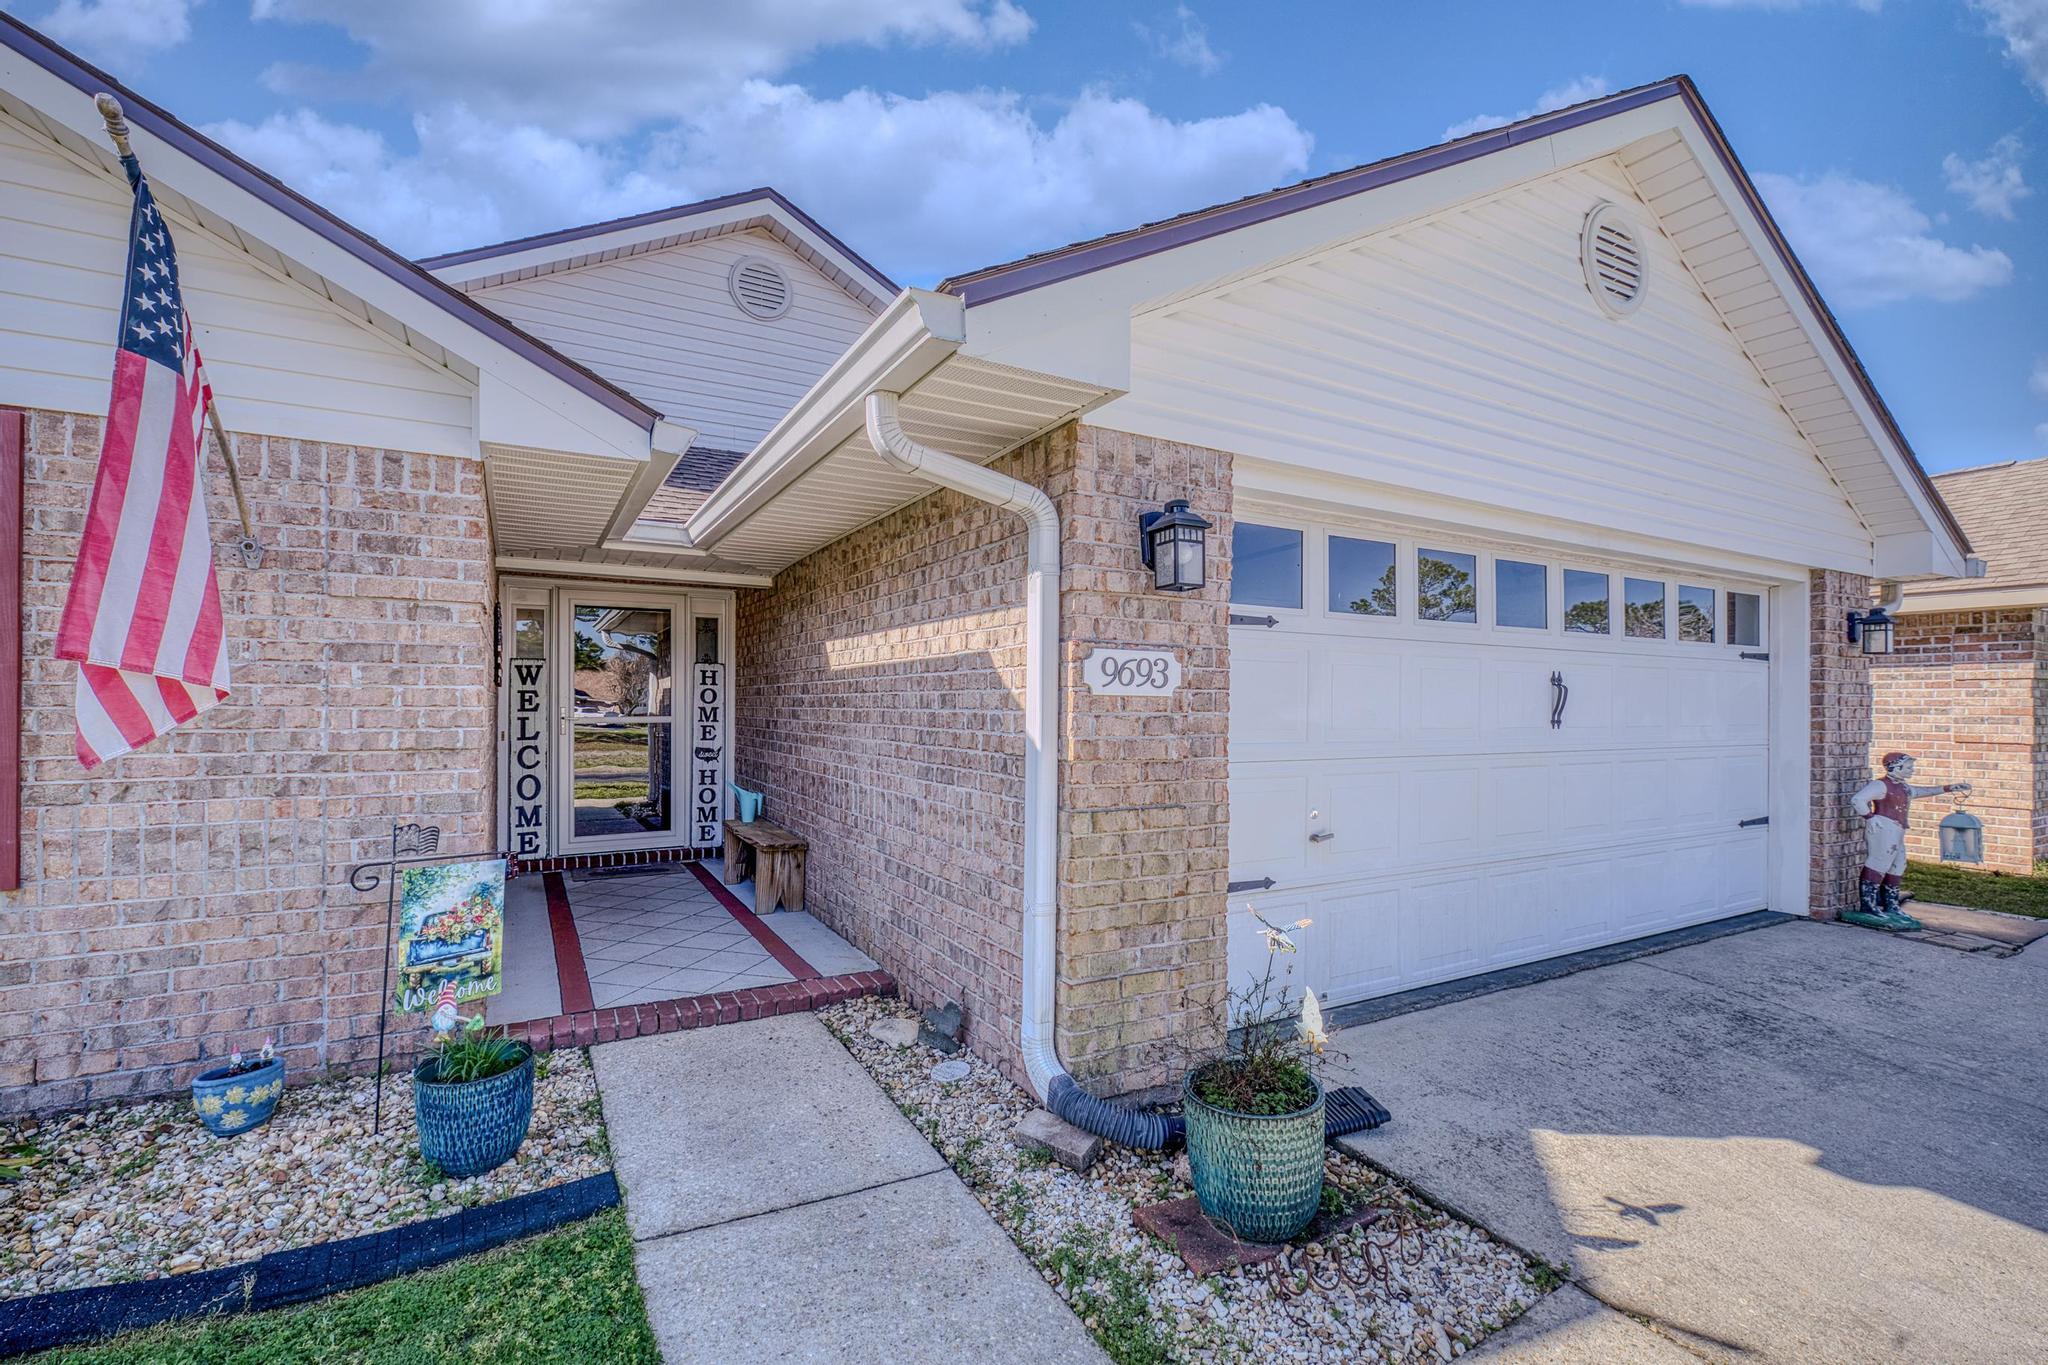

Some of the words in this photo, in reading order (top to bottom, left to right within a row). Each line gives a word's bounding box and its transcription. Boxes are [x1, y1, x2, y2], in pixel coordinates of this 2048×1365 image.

[698, 669, 719, 741] HOME
[1101, 656, 1169, 689] 9693
[515, 664, 543, 855] WELCOME
[696, 769, 718, 842] HOME
[403, 976, 497, 1011] Welome
